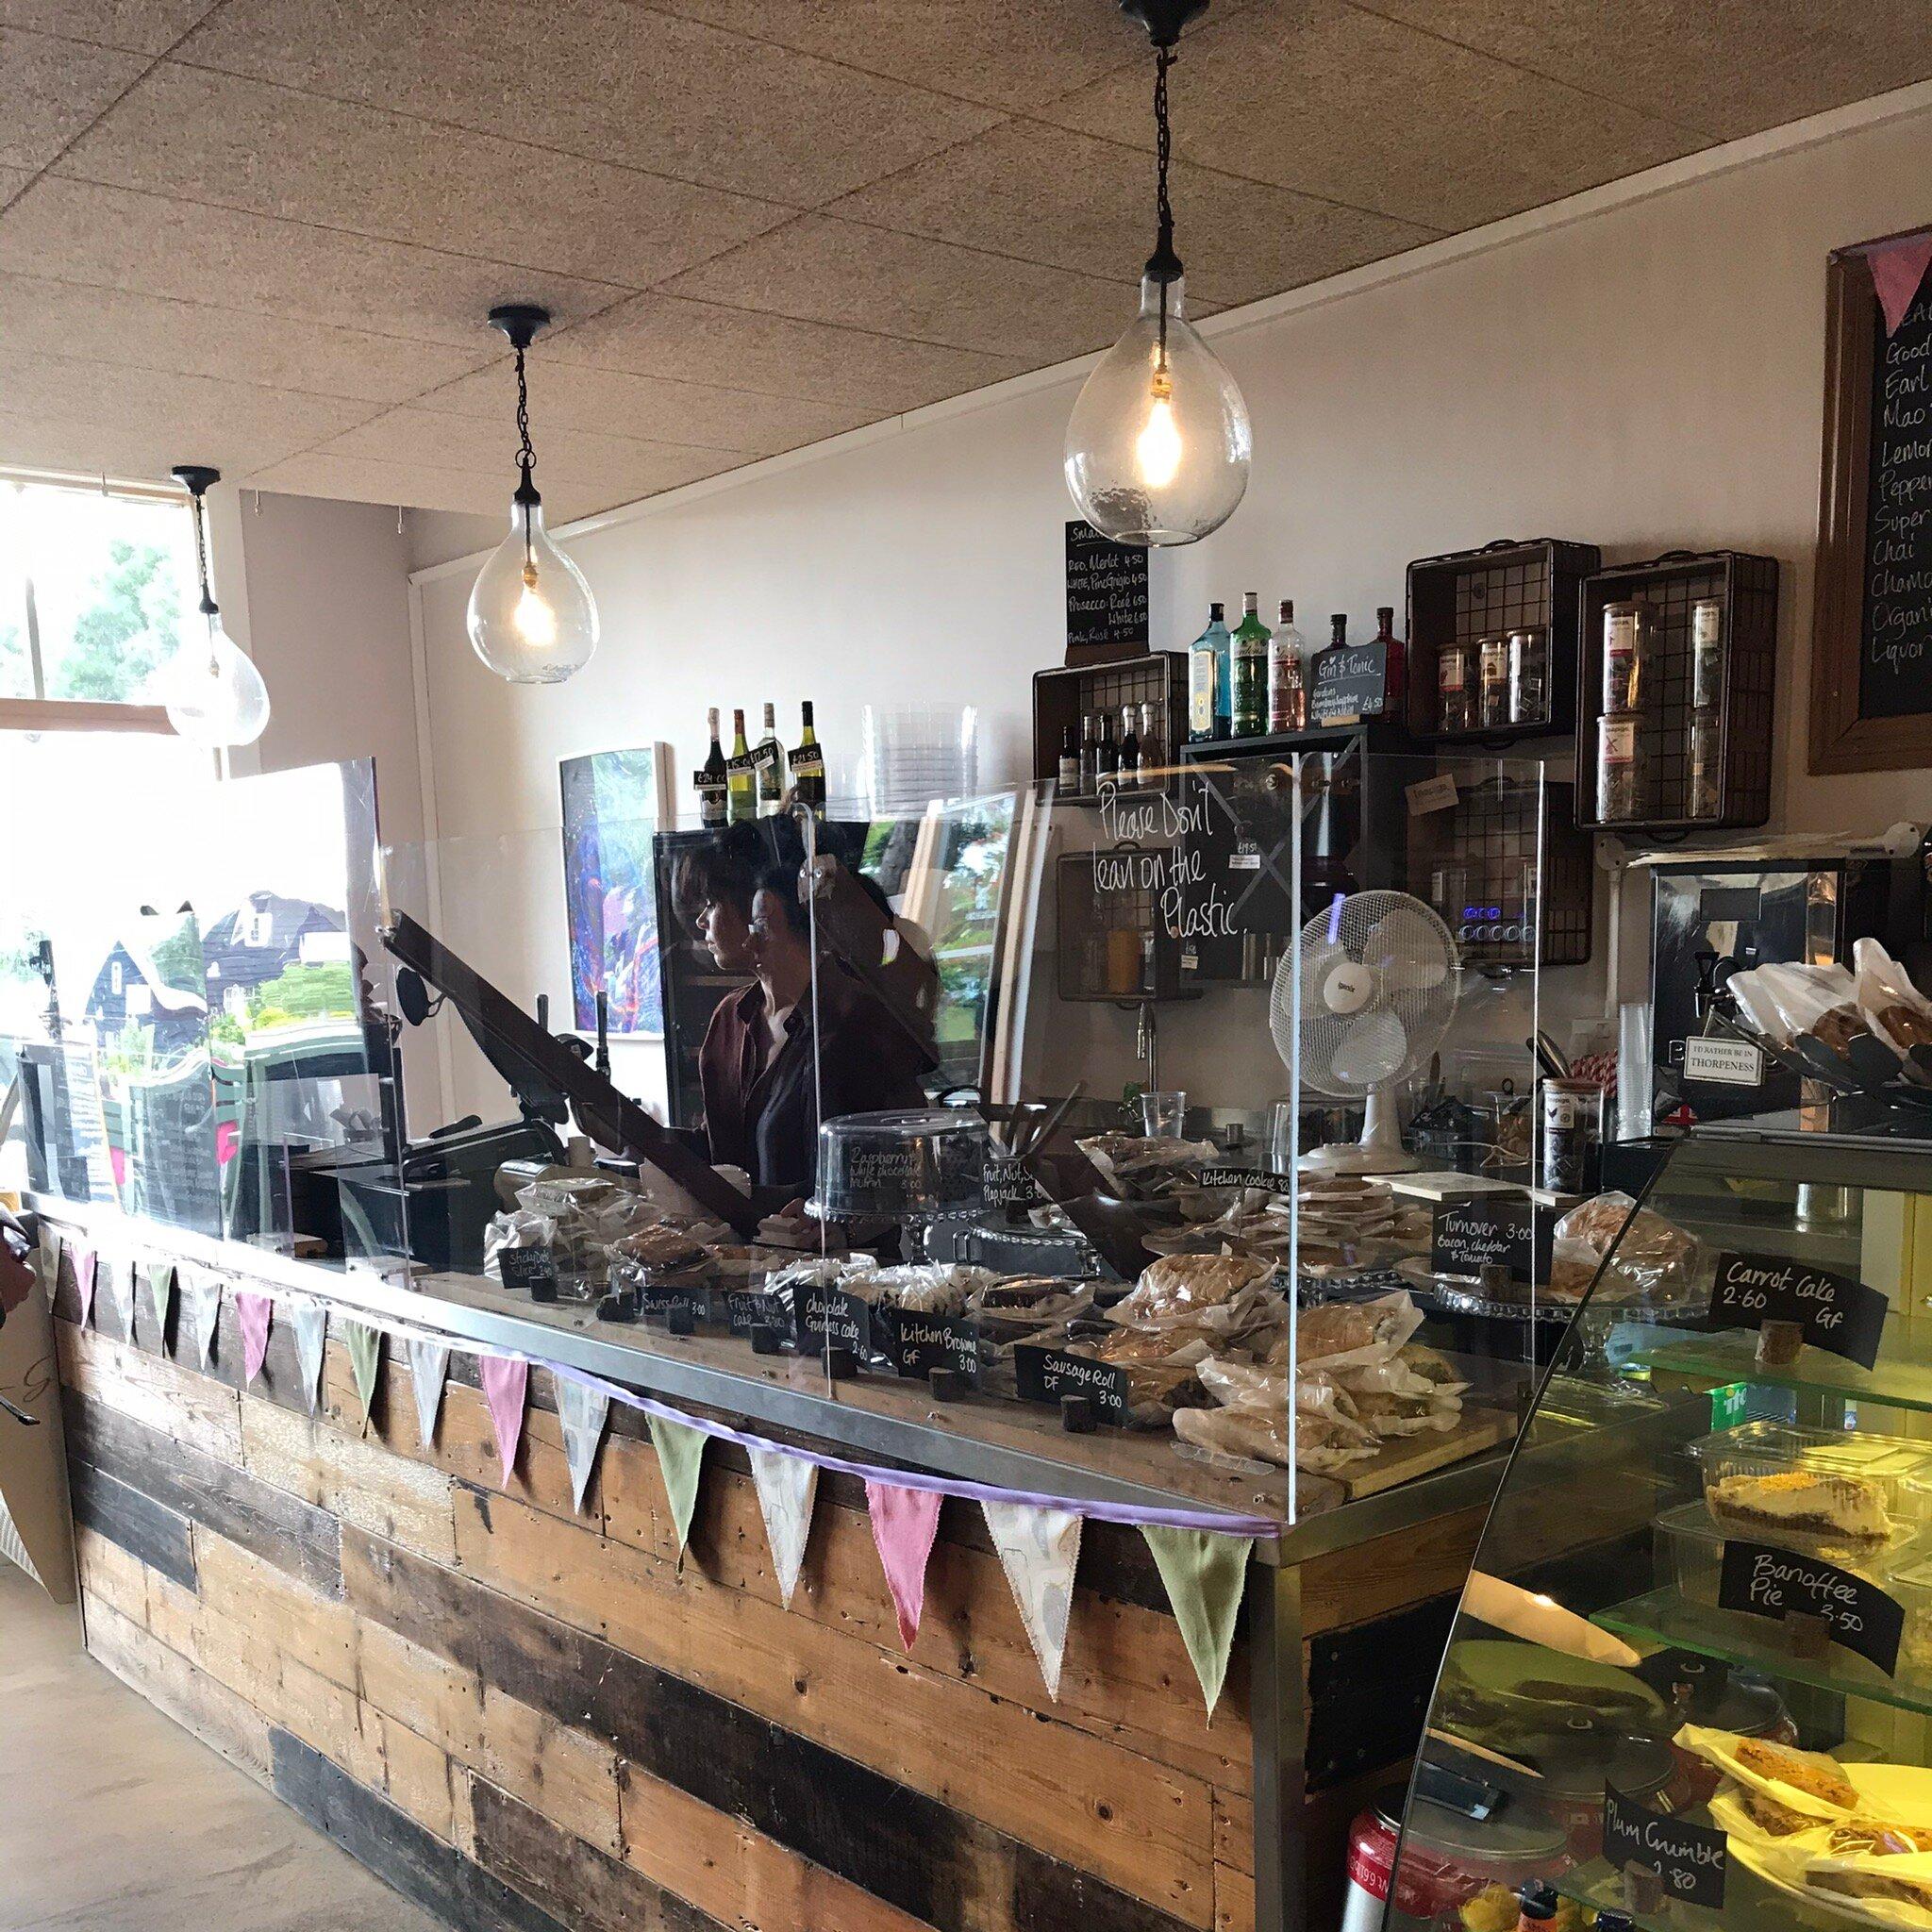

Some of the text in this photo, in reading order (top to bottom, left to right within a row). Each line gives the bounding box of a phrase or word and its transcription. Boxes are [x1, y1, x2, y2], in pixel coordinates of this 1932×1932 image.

[1886, 333, 1931, 365] Good
[1885, 364, 1929, 399] Earl
[1874, 506, 1930, 539] Super
[1874, 532, 1914, 565] Chai
[1318, 656, 1337, 679] Gin
[1346, 653, 1376, 675] Tonic
[1096, 780, 1213, 841] Please Don't
[1092, 841, 1206, 892] lean on the
[1690, 1057, 1755, 1073] THORPENESS
[1704, 1046, 1732, 1057] RATHER
[1744, 1049, 1753, 1058] IN
[1438, 1210, 1498, 1237] Turnover
[1725, 1261, 1793, 1291] Carrot
[902, 1348, 922, 1366] GF
[1042, 1354, 1116, 1390] Sausage Roll
[1043, 1375, 1059, 1391] DF
[1749, 1576, 1785, 1607] Pie
[1753, 1554, 1858, 1606] Banoffee
[1606, 1798, 1724, 1871] Plum Crumble
